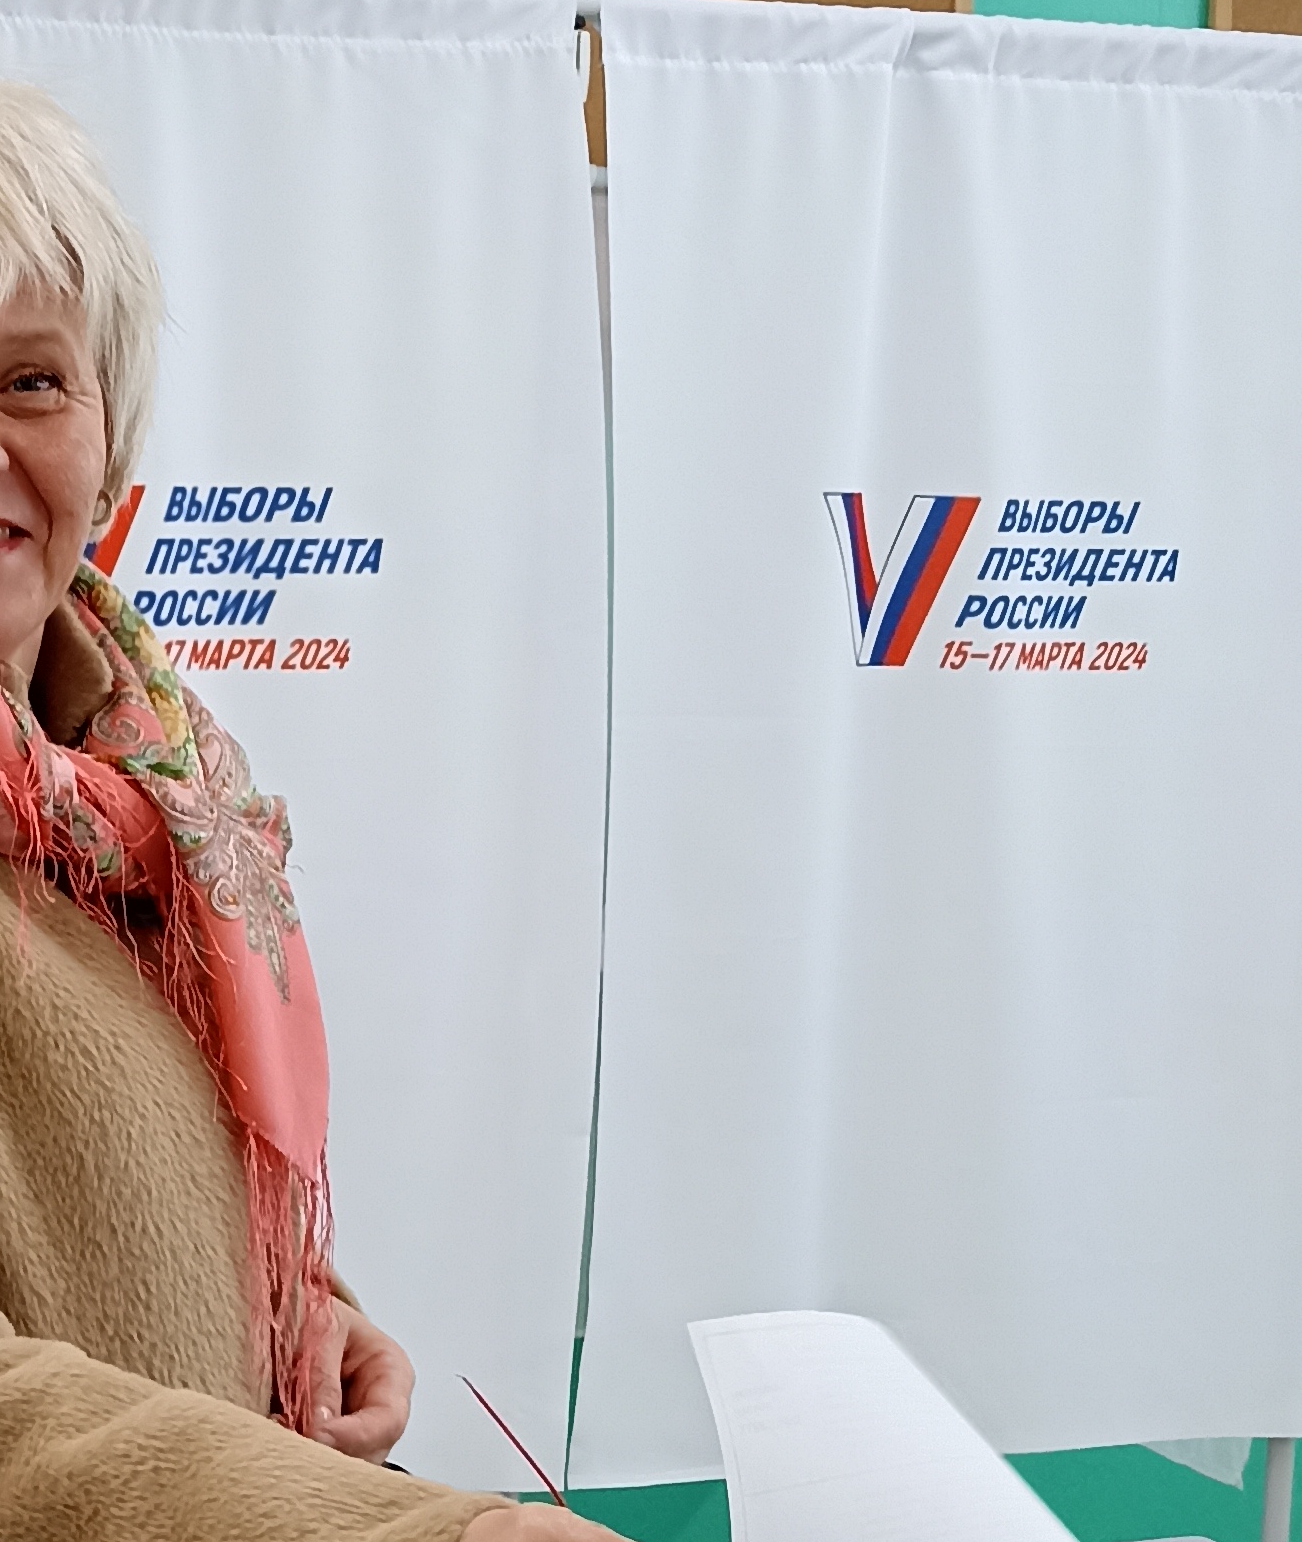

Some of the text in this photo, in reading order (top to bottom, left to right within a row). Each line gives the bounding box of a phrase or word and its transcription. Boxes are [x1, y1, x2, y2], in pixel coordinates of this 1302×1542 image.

[163, 485, 333, 523] ВЫБОРЫ
[997, 499, 1141, 534] ВЫБОРЫ
[145, 537, 384, 580] ПРЕЗИДЕНТА
[977, 547, 1180, 587] ПРЕЗИДЕНТА
[133, 589, 277, 626] РОССИИ
[954, 594, 1087, 630] РОССИИ
[186, 638, 277, 671] МАРТА
[281, 637, 351, 671] 2024
[1015, 641, 1086, 671] МАРТА
[1088, 641, 1149, 671] 2024
